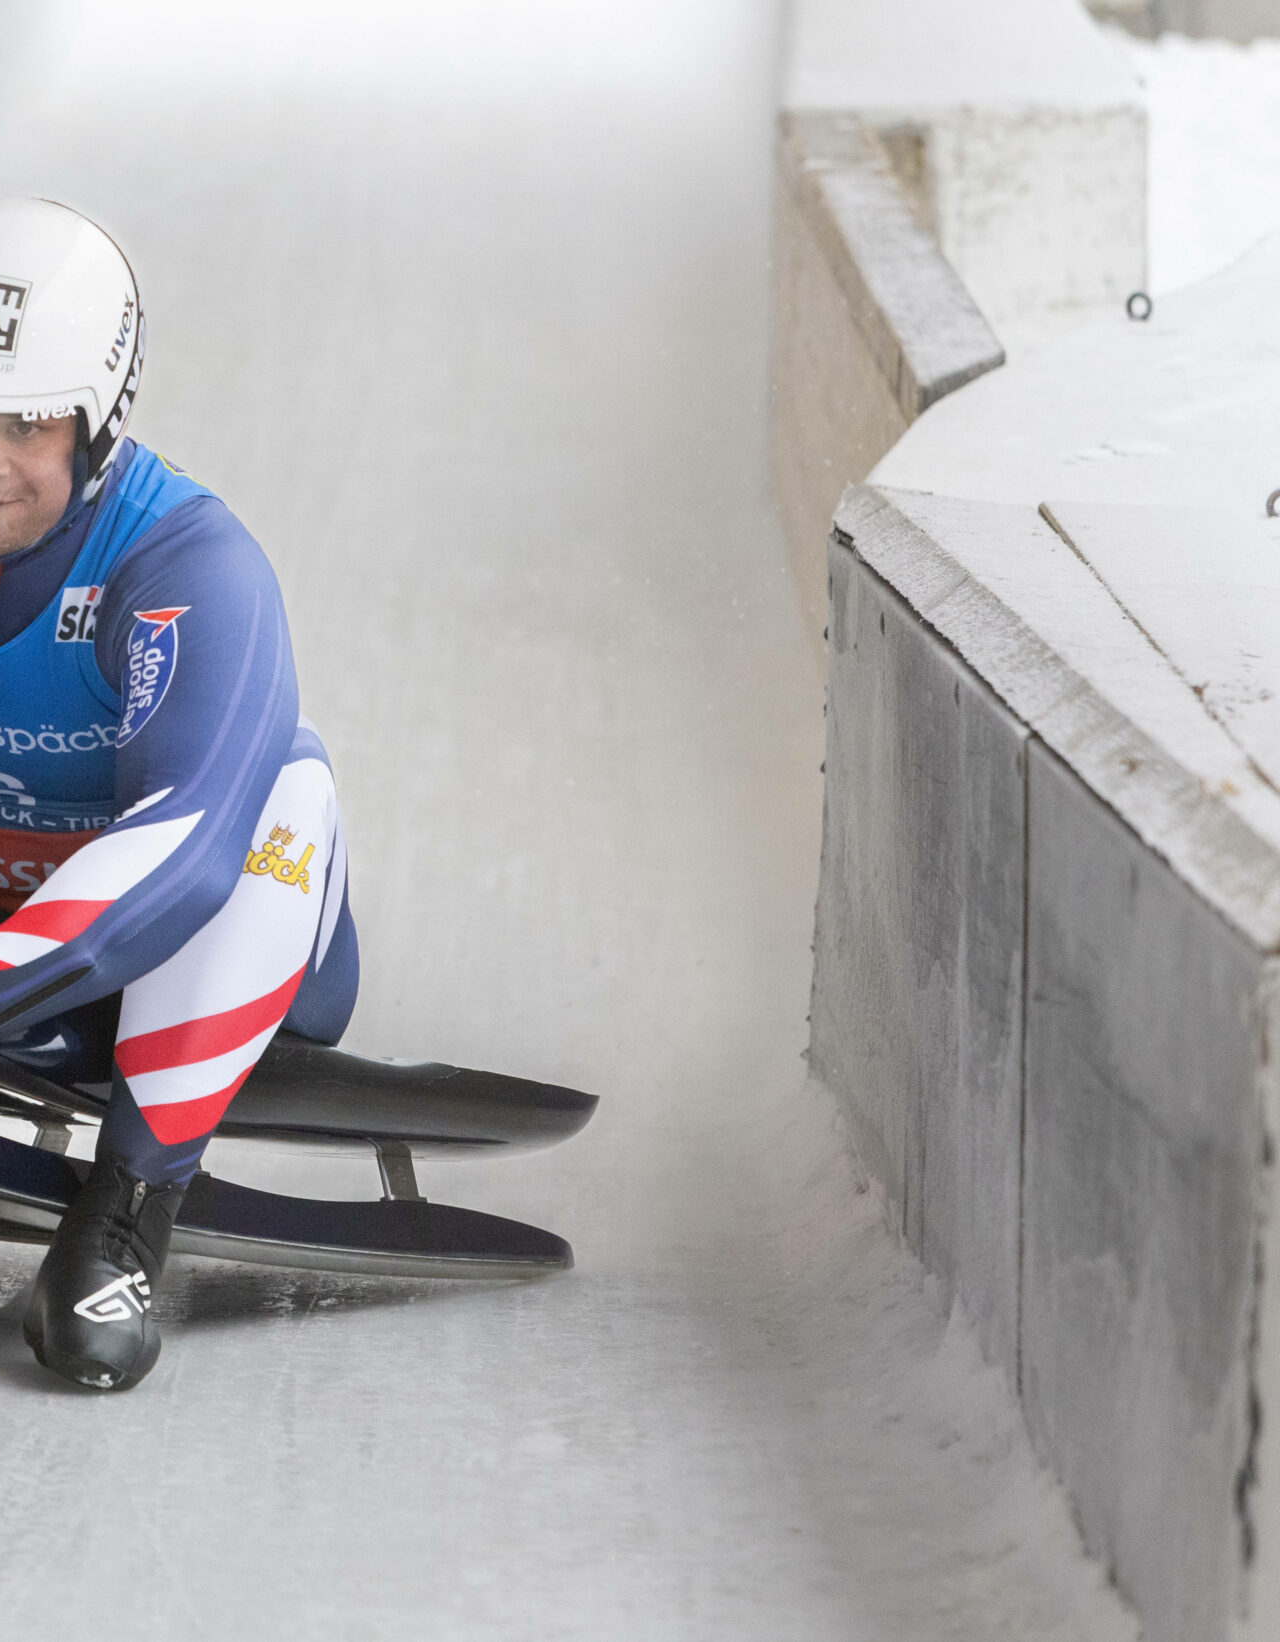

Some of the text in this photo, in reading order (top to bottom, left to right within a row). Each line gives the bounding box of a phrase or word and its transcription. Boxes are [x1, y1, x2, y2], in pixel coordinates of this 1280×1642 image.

[104, 291, 134, 372] uvex
[107, 302, 146, 439] uve
[22, 404, 77, 421] uvex
[119, 638, 145, 738] persona
[137, 647, 165, 709] shop
